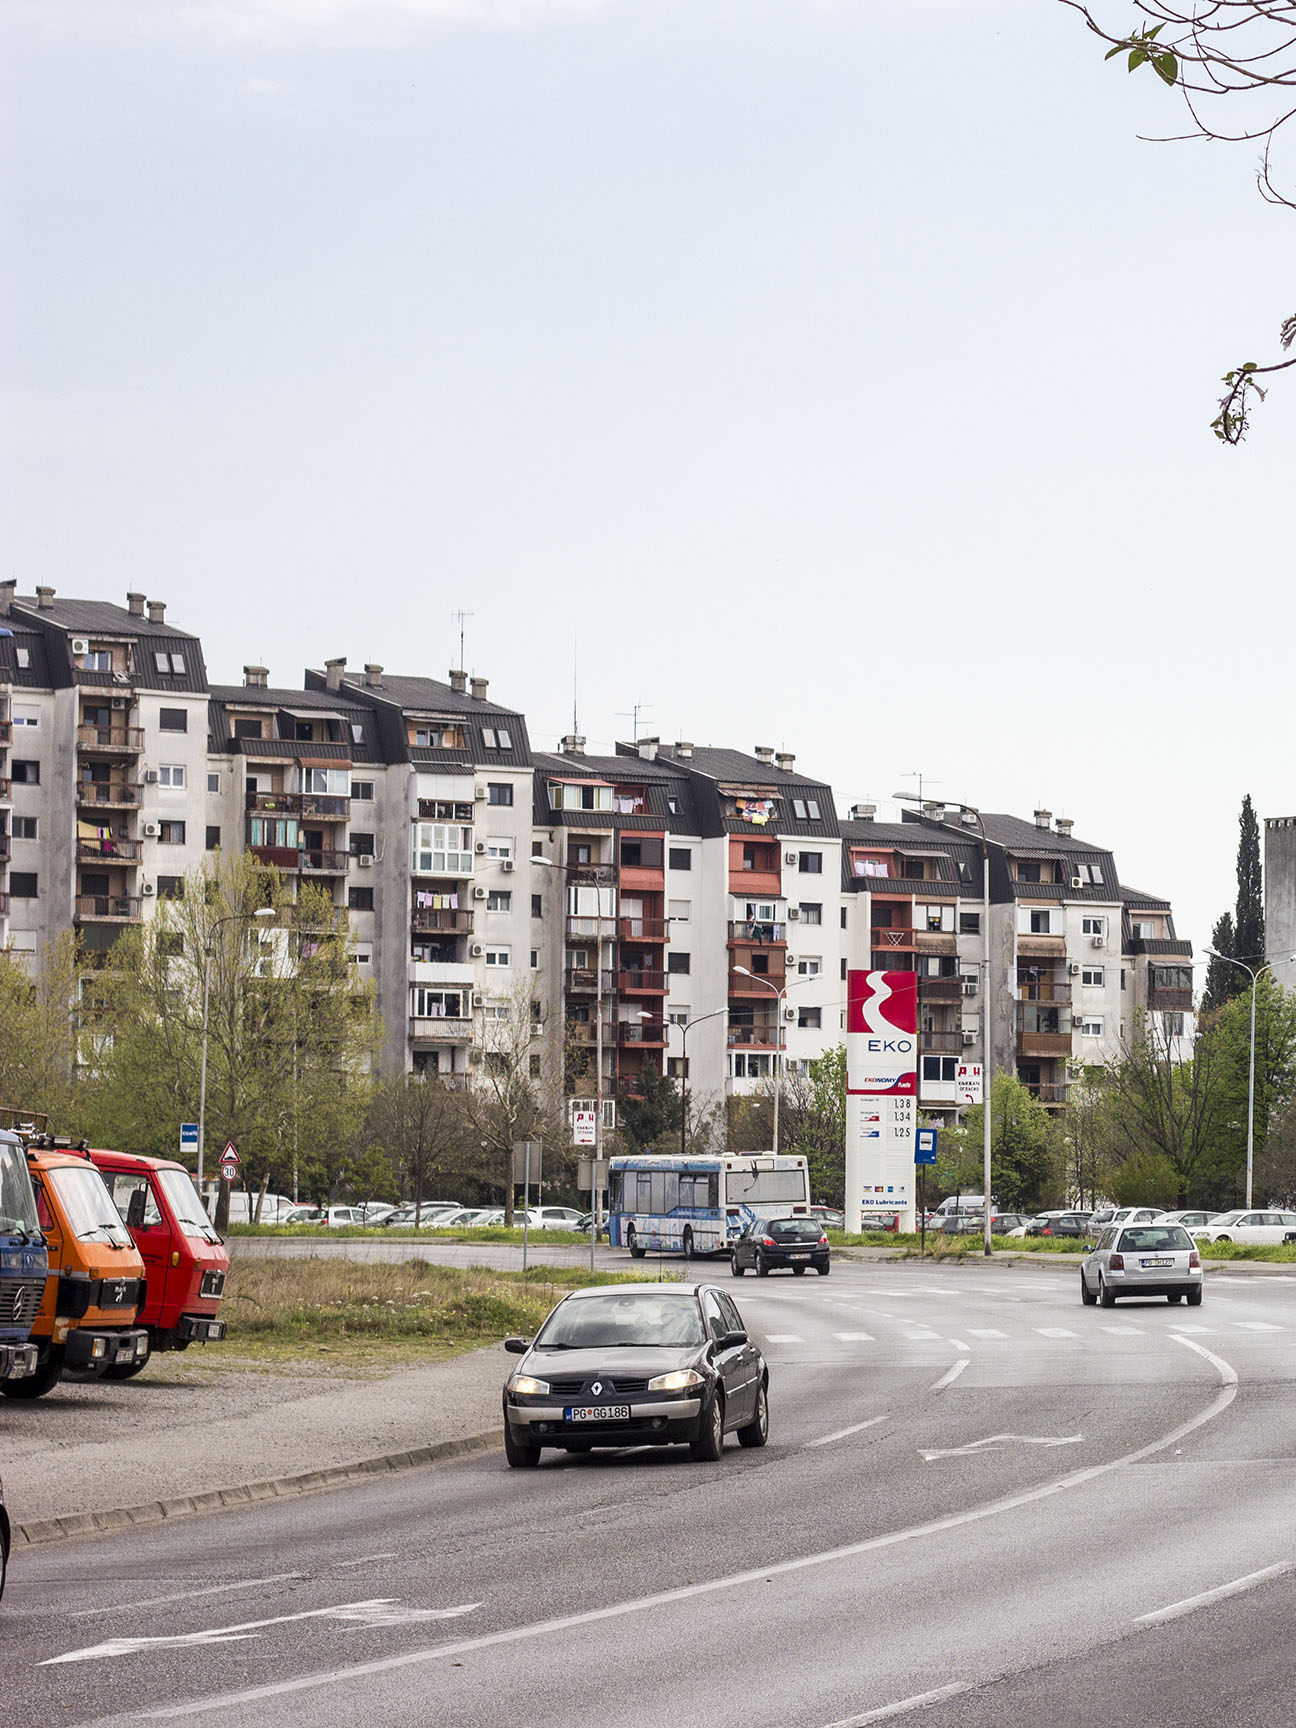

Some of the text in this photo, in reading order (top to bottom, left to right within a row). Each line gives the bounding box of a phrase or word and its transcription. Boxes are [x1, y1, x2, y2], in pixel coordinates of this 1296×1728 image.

[868, 1039, 912, 1053] EKO
[224, 1167, 235, 1176] 30
[573, 1406, 628, 1419] PG GG186
